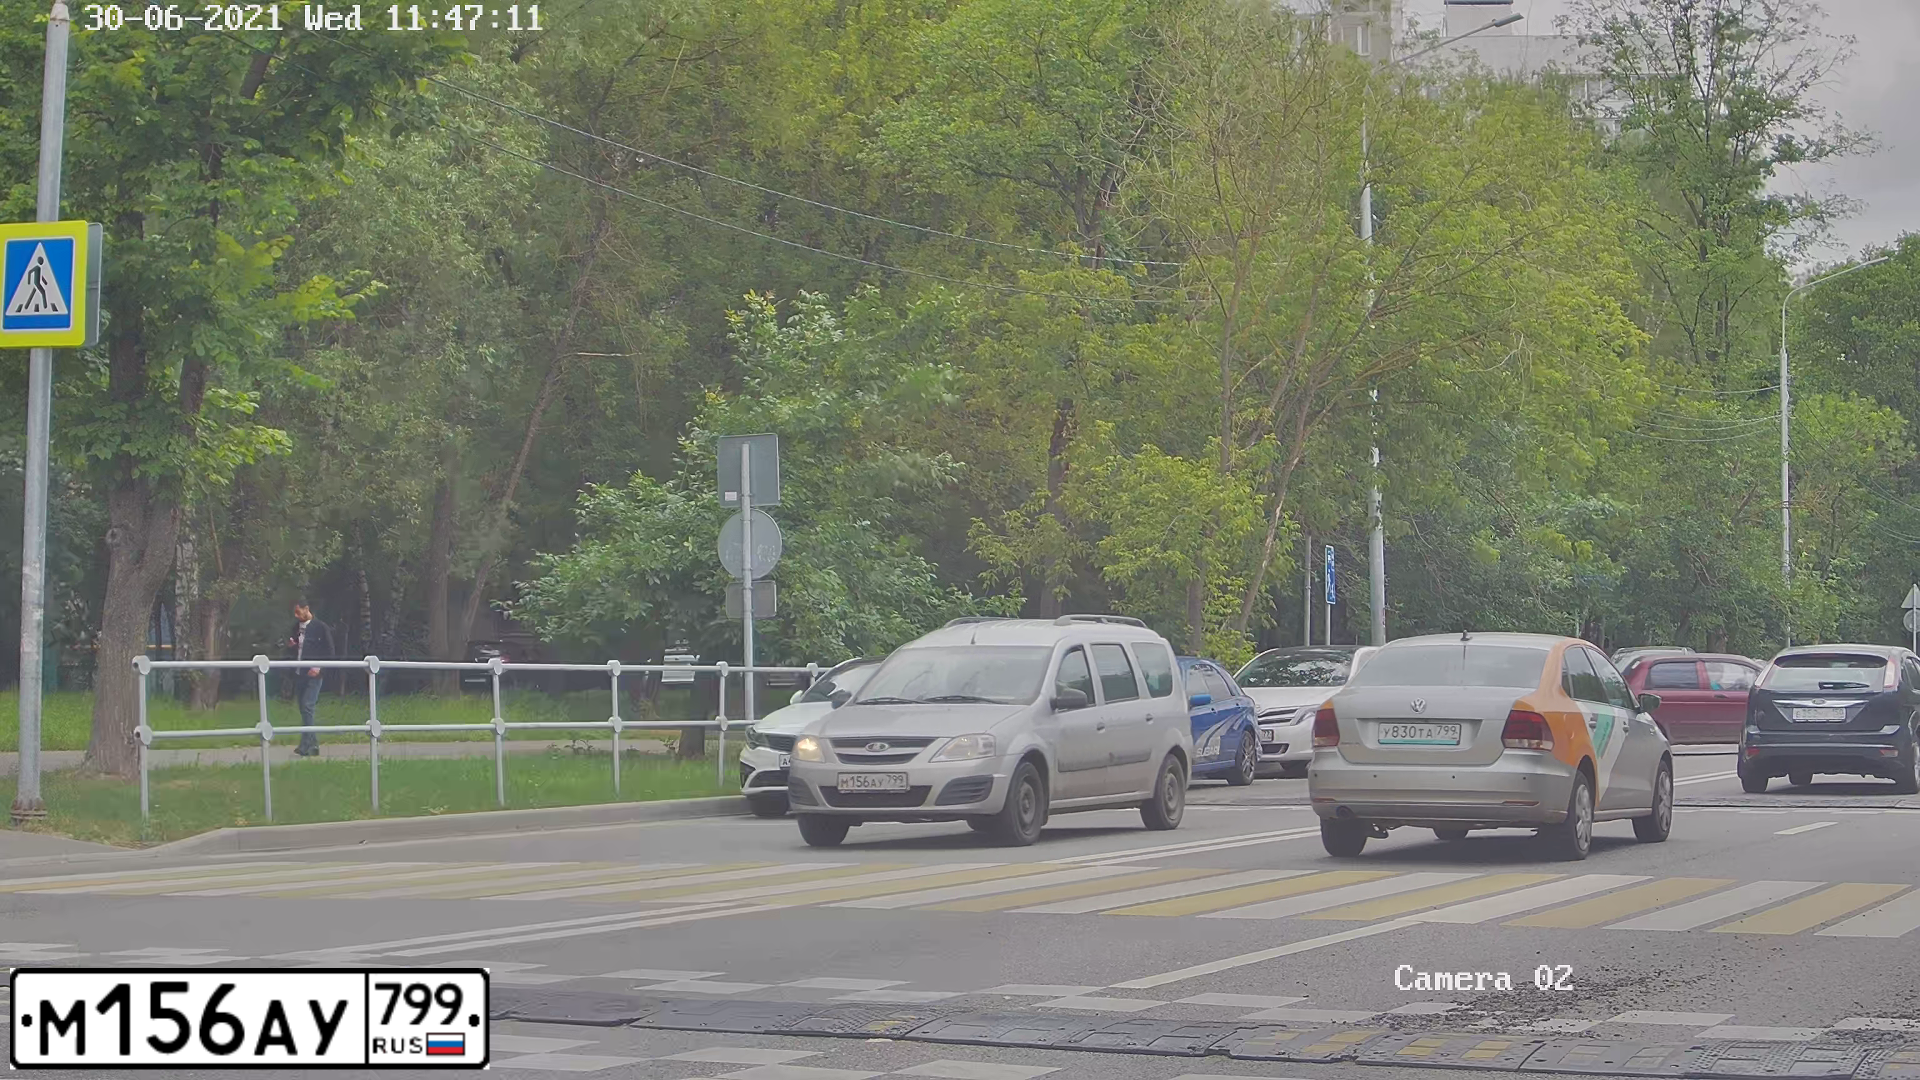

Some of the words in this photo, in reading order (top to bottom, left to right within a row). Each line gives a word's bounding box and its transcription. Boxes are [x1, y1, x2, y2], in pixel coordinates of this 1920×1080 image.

[1383, 725, 1433, 739] У830ТА
[1437, 725, 1457, 736] 799
[841, 775, 884, 788] М156АУ
[886, 774, 904, 785] 799
